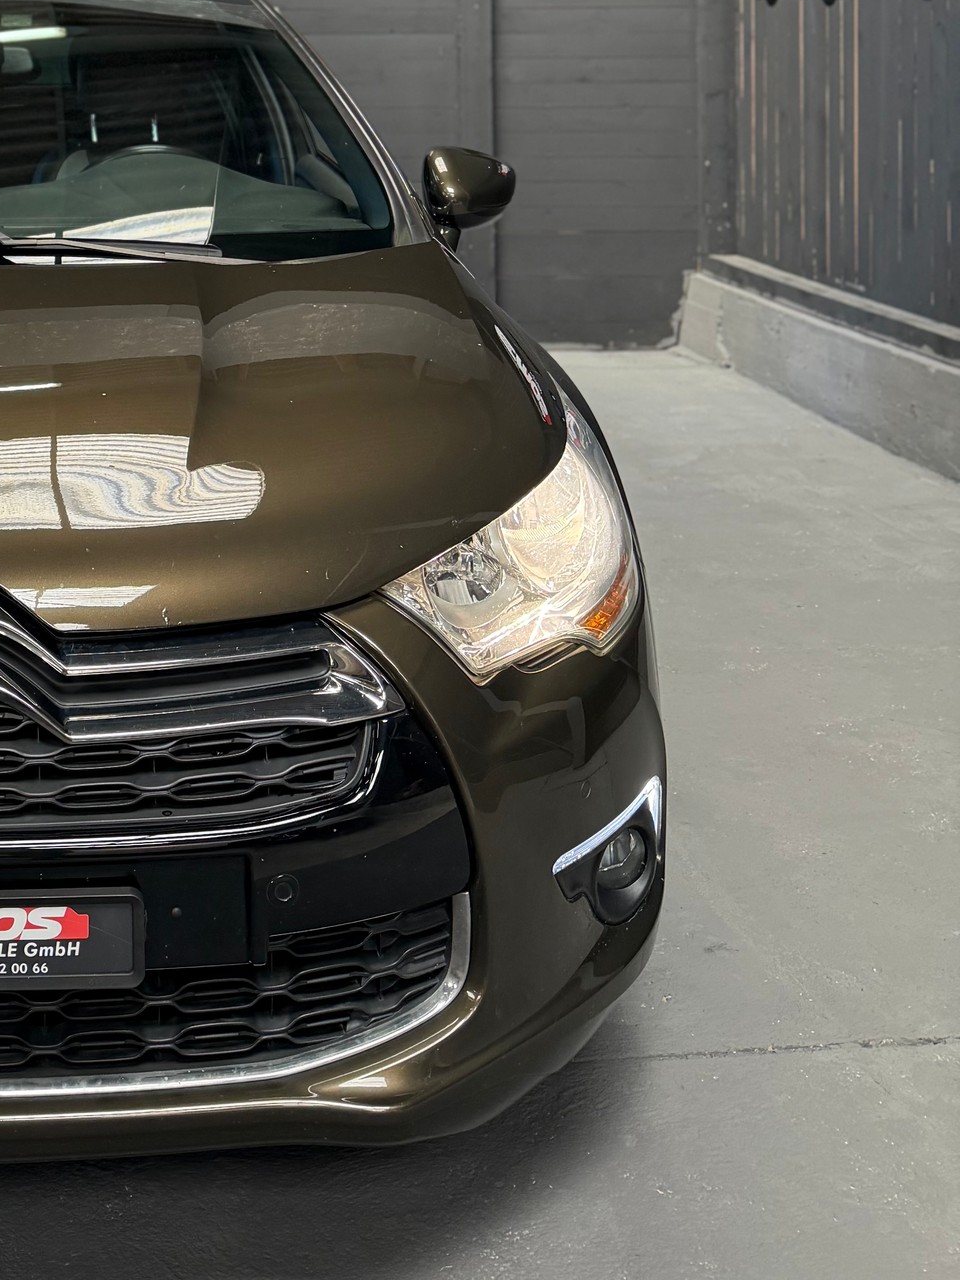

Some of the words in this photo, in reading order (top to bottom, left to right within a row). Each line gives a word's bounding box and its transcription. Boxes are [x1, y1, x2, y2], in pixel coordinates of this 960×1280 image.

[23, 941, 81, 957] GmbH
[11, 963, 28, 974] 00
[32, 962, 49, 974] 66
